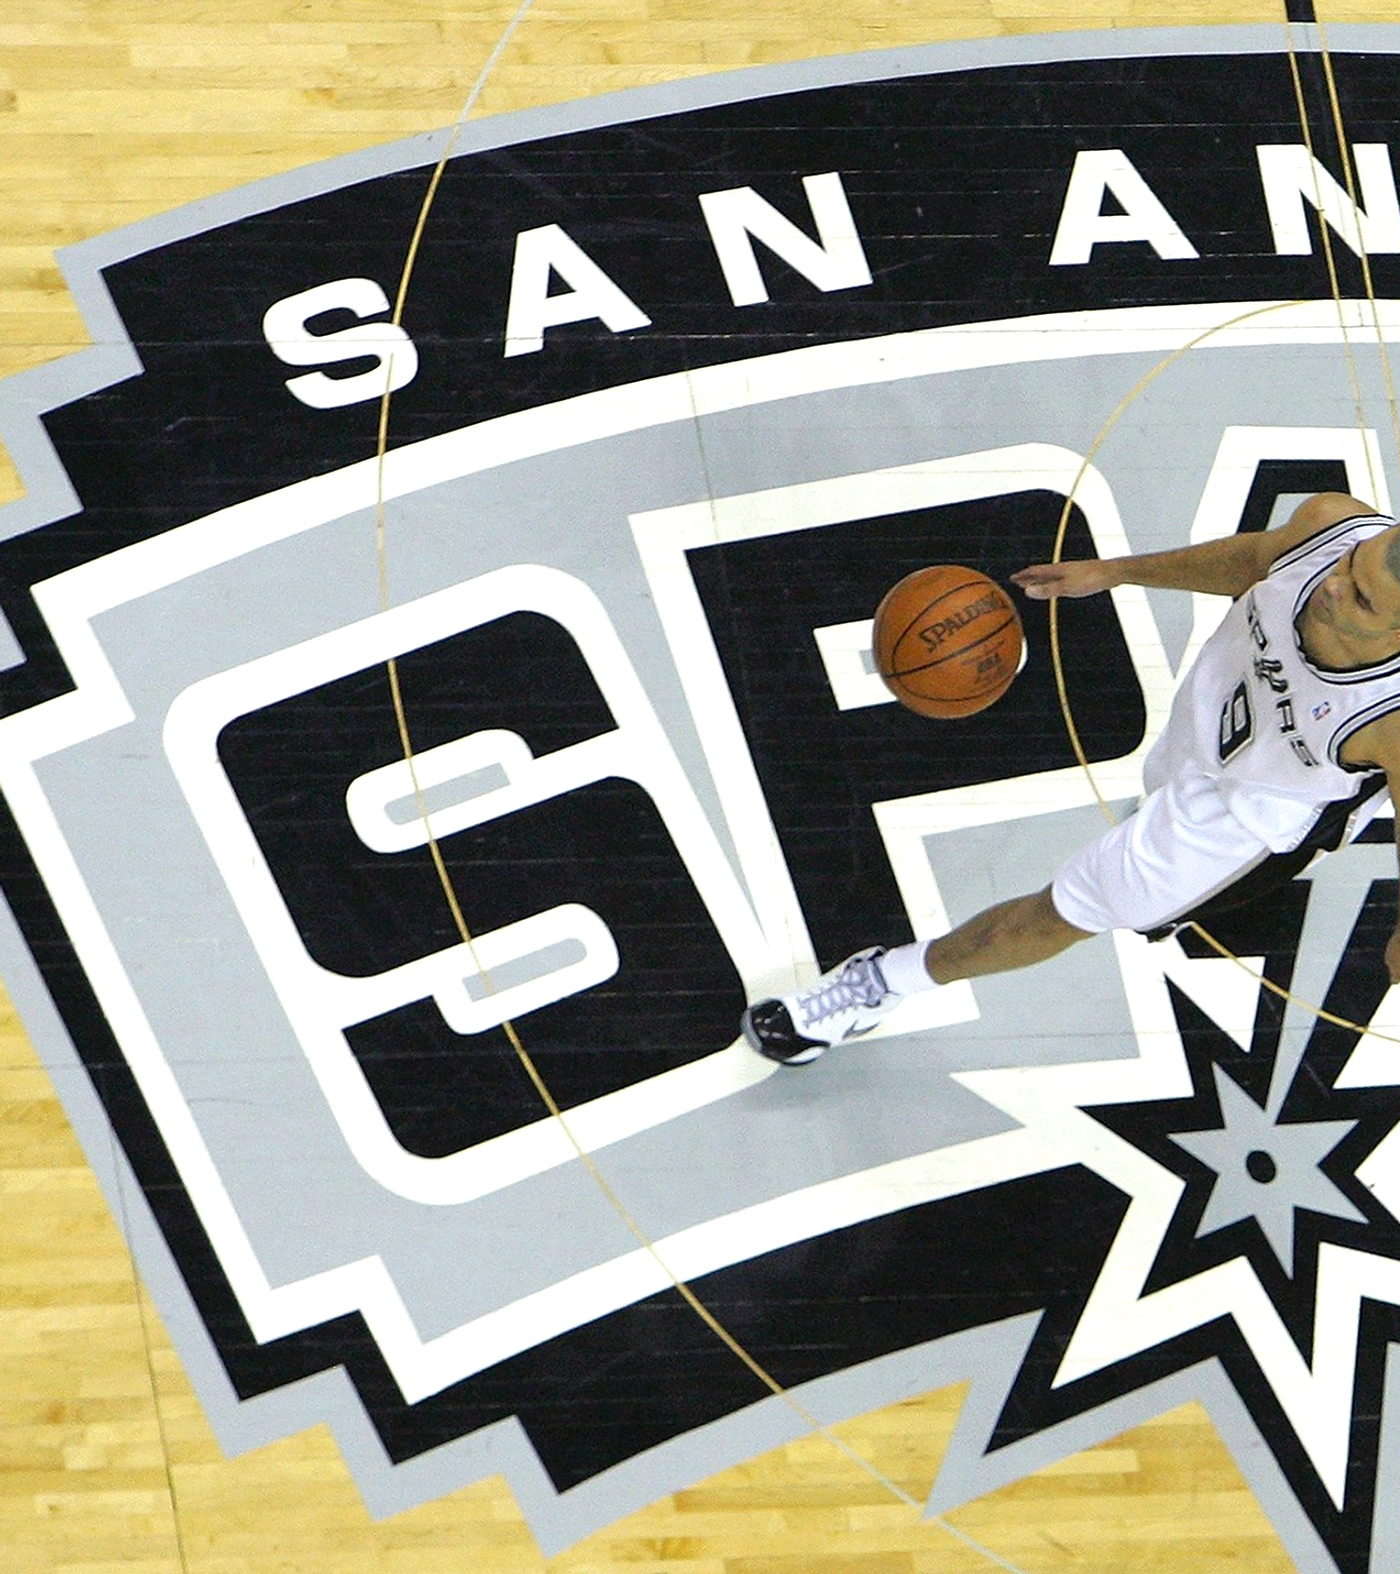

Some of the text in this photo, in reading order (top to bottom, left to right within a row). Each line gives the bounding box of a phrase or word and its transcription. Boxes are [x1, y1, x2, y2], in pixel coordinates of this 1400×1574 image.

[262, 171, 873, 410] SAN
[1217, 676, 1254, 766] 9
[1246, 588, 1319, 766] SPURS
